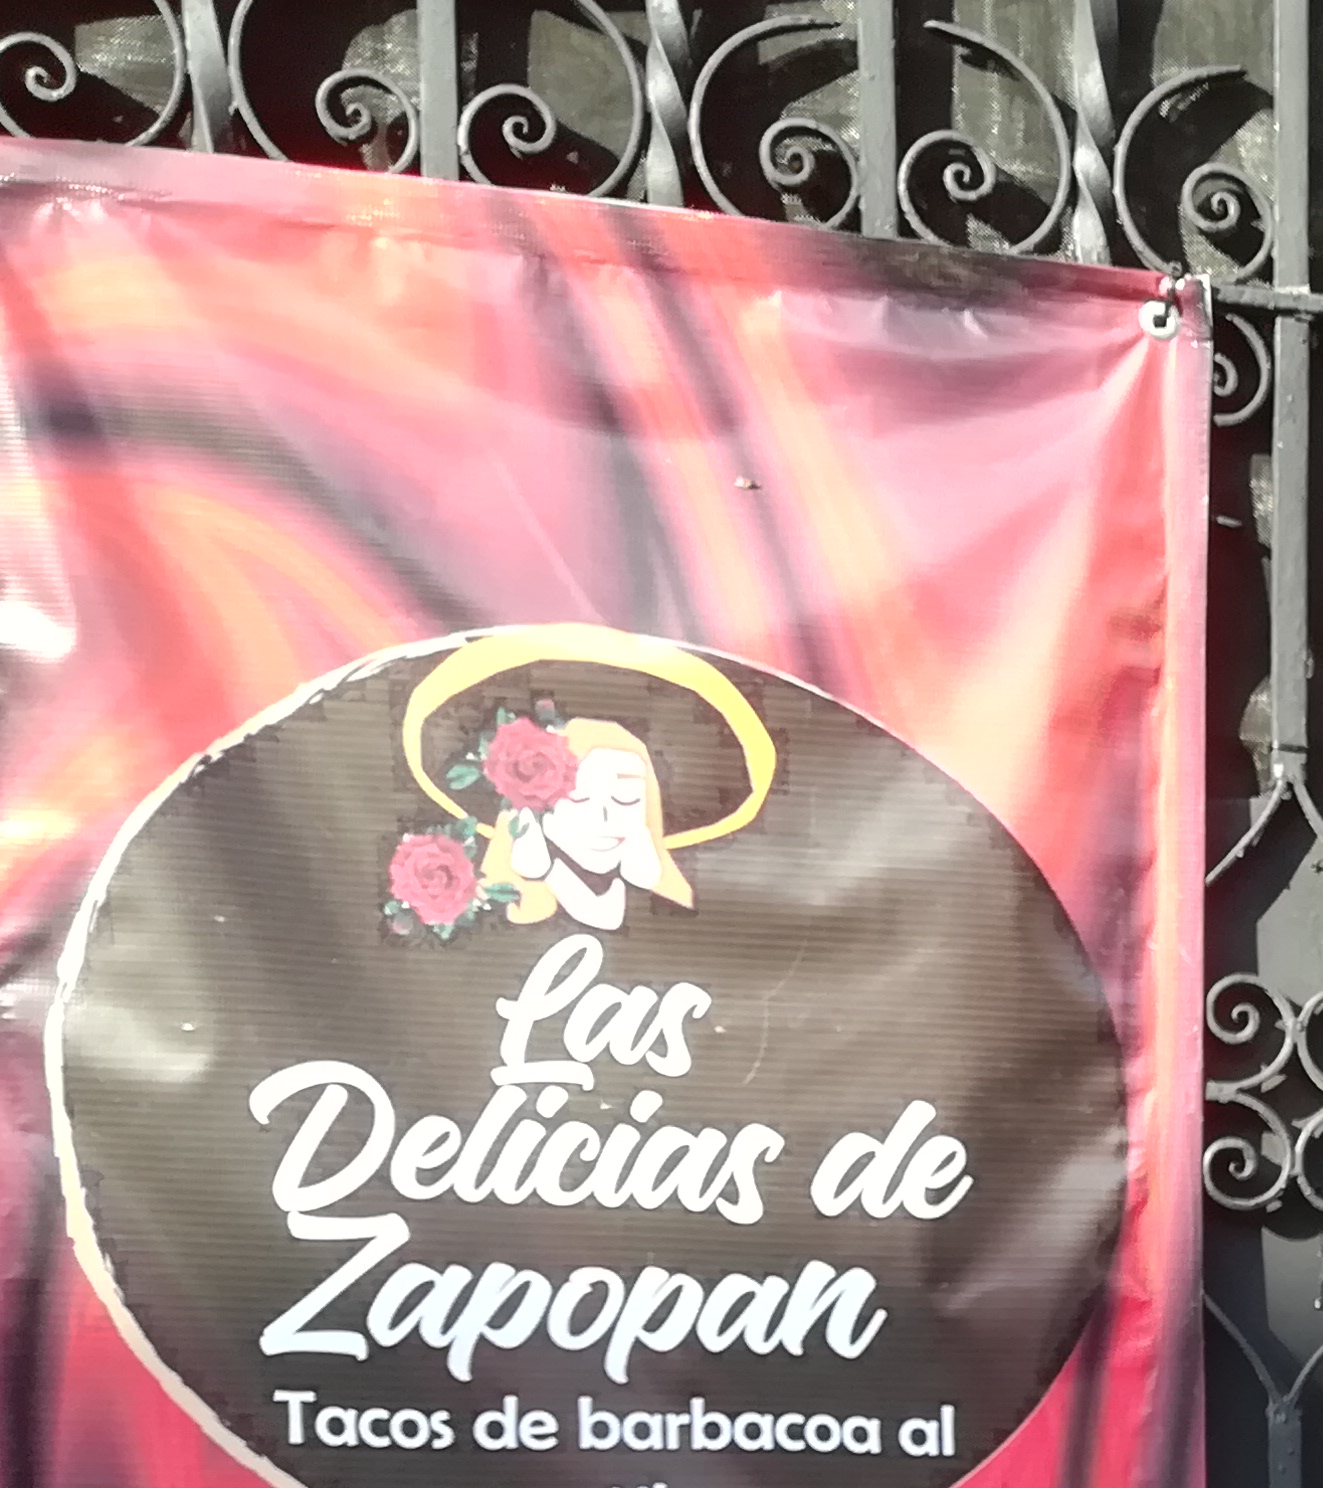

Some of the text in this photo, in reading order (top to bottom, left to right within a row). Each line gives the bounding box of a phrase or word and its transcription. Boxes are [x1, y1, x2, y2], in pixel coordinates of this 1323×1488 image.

[490, 934, 711, 1092] Las
[248, 1059, 973, 1225] Delicias de
[260, 1212, 887, 1384] Zapopan
[273, 1390, 955, 1458] Tacos de barbacoa al
